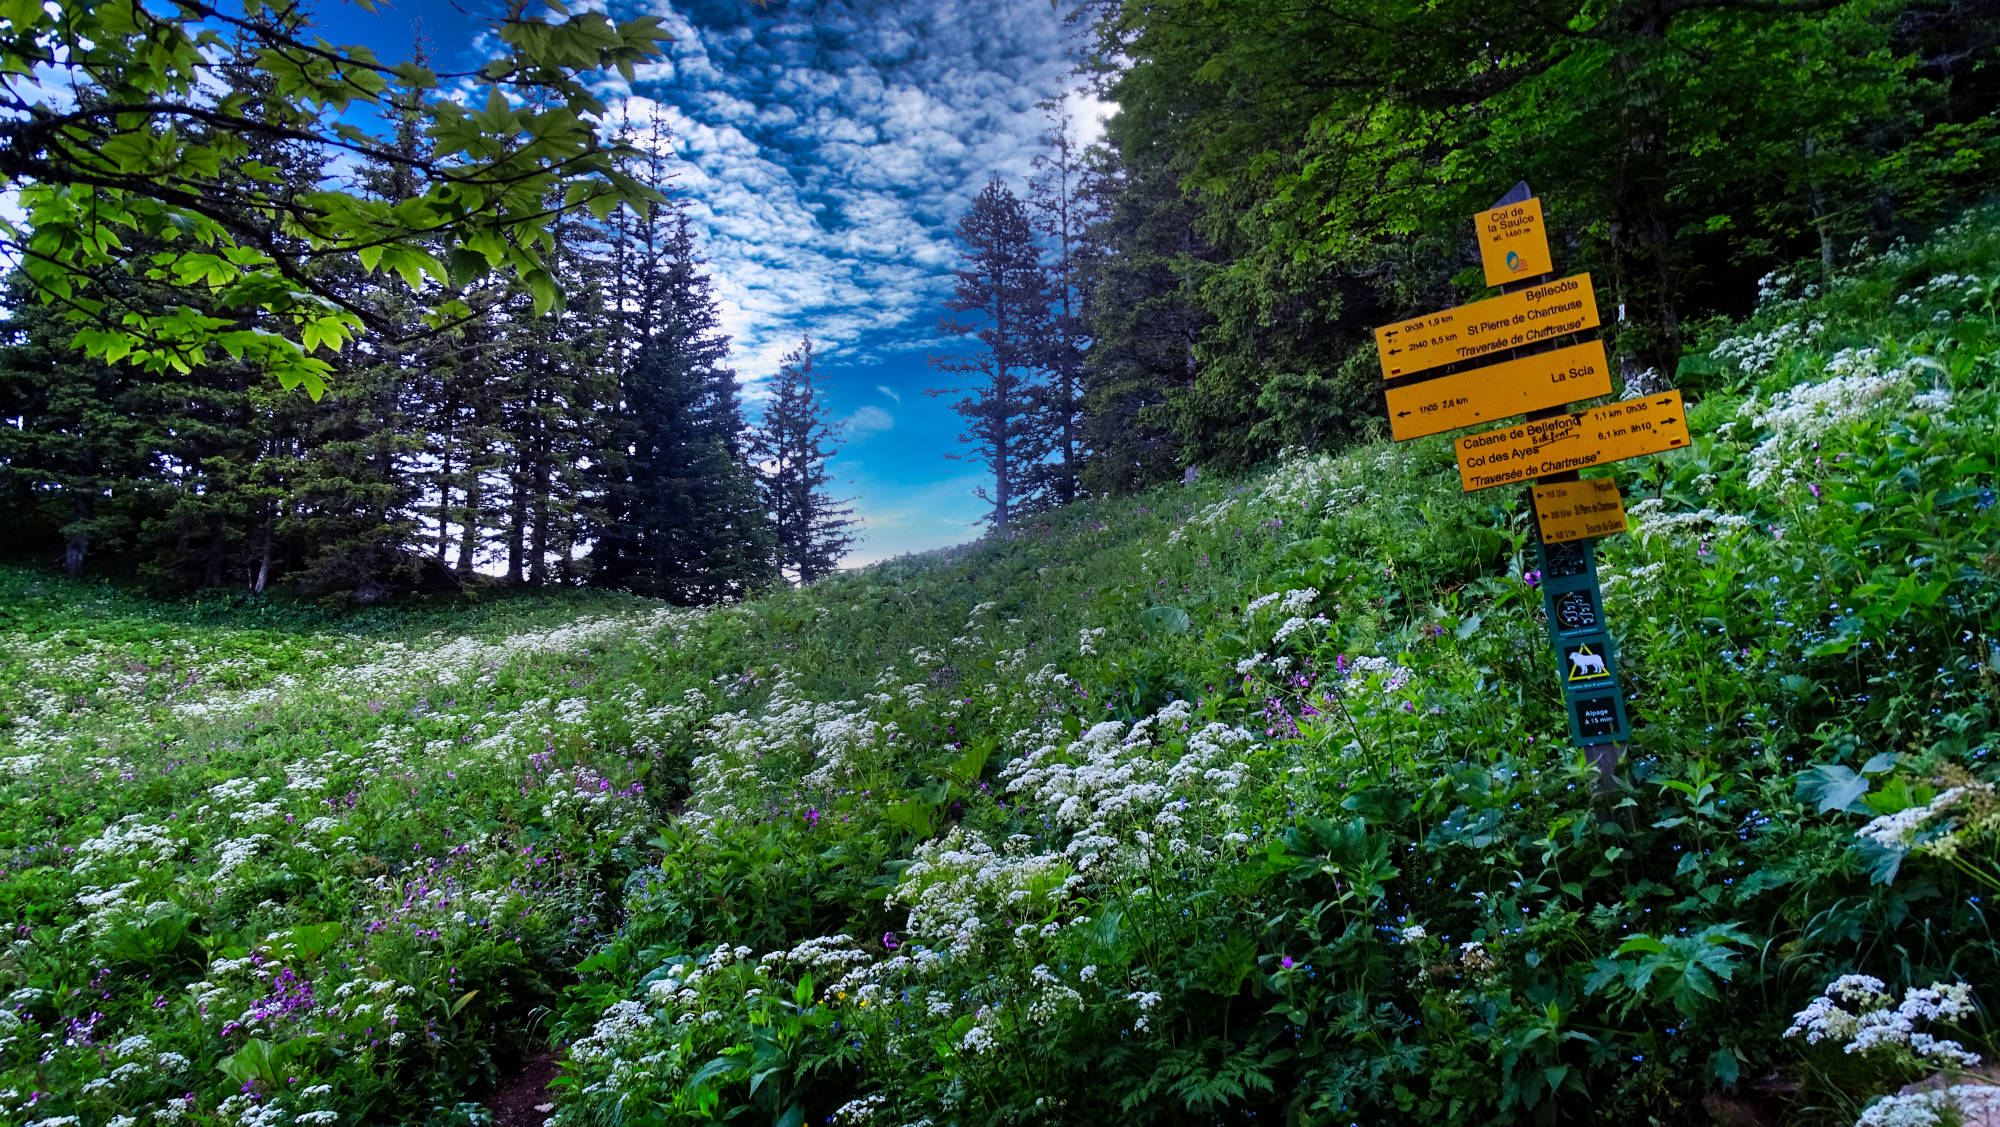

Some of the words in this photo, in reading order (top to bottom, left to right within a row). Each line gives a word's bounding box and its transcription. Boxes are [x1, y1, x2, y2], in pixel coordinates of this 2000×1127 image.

[1488, 224, 1497, 233] la
[1500, 215, 1534, 230] Saulce
[1491, 210, 1508, 222] Col
[1511, 208, 1524, 217] de
[1525, 281, 1578, 301] Bellecôte
[1404, 322, 1424, 333] 0h35
[1441, 315, 1454, 323] km
[1467, 325, 1479, 336] St
[1480, 318, 1510, 333] Pierre
[1512, 314, 1525, 325] de
[1527, 300, 1583, 320] Chartreuse
[1408, 340, 1428, 351] 2h40
[1445, 333, 1458, 341] km
[1511, 335, 1524, 344] de
[1551, 371, 1566, 383] La
[1569, 366, 1594, 379] Scia
[1456, 397, 1469, 406] km
[1594, 411, 1607, 421] 1,1
[1609, 410, 1622, 418] km
[1626, 403, 1648, 414] 0h35
[1463, 432, 1507, 449] Cabane
[1509, 429, 1524, 440] de
[1598, 430, 1611, 440] 6,1
[1613, 429, 1627, 437] km
[1467, 457, 1486, 468] Col
[1488, 452, 1509, 464] des
[1512, 445, 1540, 459] Ayes
[1525, 466, 1539, 477] de
[1541, 450, 1601, 473] Chartreuse"
[1585, 709, 1608, 717] Alpage
